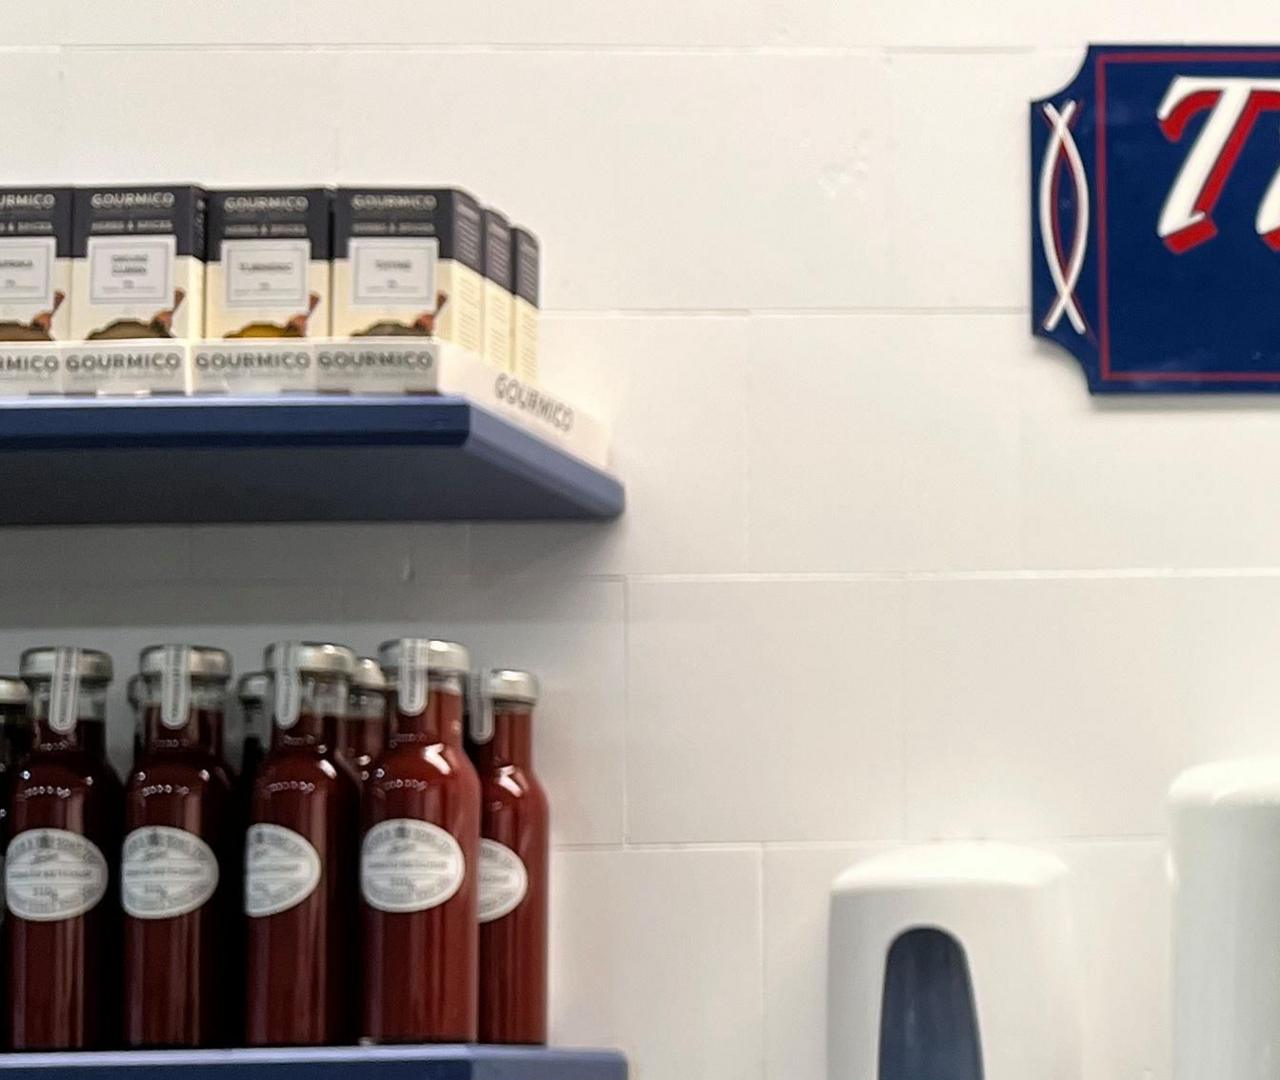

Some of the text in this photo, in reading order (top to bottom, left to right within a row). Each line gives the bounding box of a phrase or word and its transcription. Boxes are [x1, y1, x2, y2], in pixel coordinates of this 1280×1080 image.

[91, 191, 175, 208] GOURMICO
[0, 355, 59, 372] MICO
[65, 352, 181, 372] GOURMICO
[196, 351, 310, 369] GOURMICO
[319, 350, 433, 369] GOURMICO
